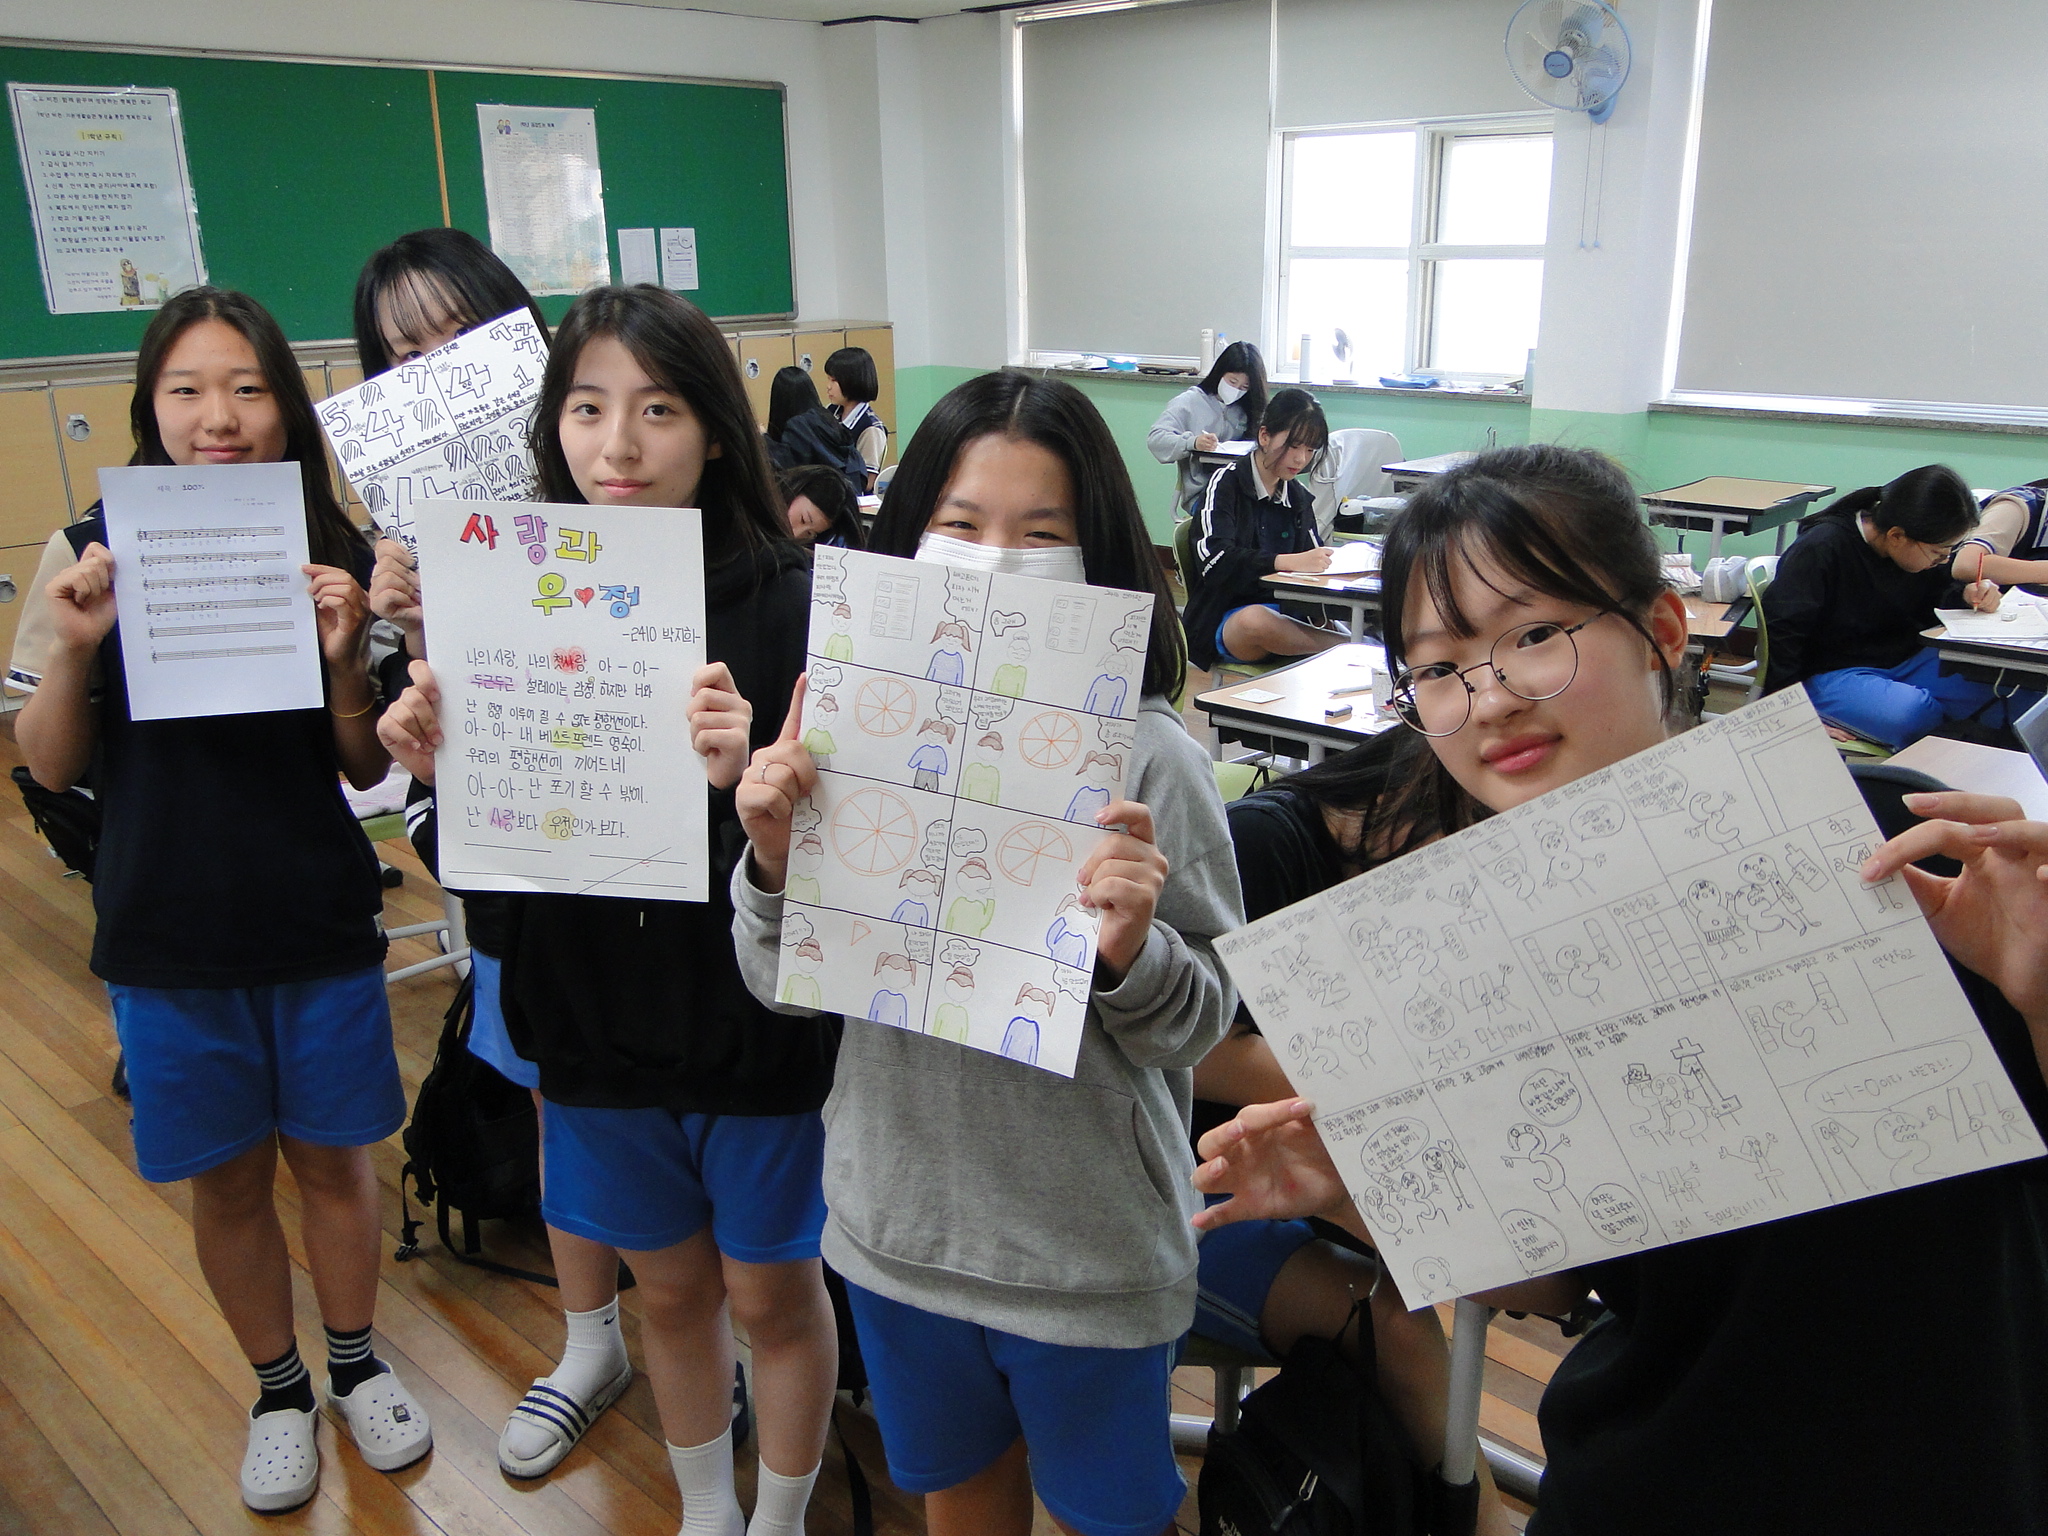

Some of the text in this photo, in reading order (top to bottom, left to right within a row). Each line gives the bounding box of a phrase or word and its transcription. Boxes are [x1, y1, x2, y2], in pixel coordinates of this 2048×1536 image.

[460, 513, 602, 565] 사랑과
[467, 648, 490, 666] 나의
[528, 654, 550, 669] 나의
[470, 674, 515, 691] 두근두근
[527, 679, 567, 697] 설레이는
[600, 680, 627, 698] 하지만
[635, 683, 653, 698] 너와
[467, 699, 477, 713] 난
[556, 712, 565, 725] 수
[571, 714, 590, 727] 없는
[594, 712, 648, 730] 평행선이다.
[520, 726, 533, 743] 내
[1739, 718, 1785, 736] 카지노
[466, 748, 626, 773] 우리의 평행선에 끼어드네
[530, 778, 542, 798] 난
[550, 780, 575, 798] 포기
[580, 781, 593, 800] 할
[599, 783, 612, 800] 수
[620, 785, 648, 803] 밖에.
[467, 807, 481, 827] 난
[490, 809, 538, 832] 사랑보다
[1826, 817, 1855, 835] 학교
